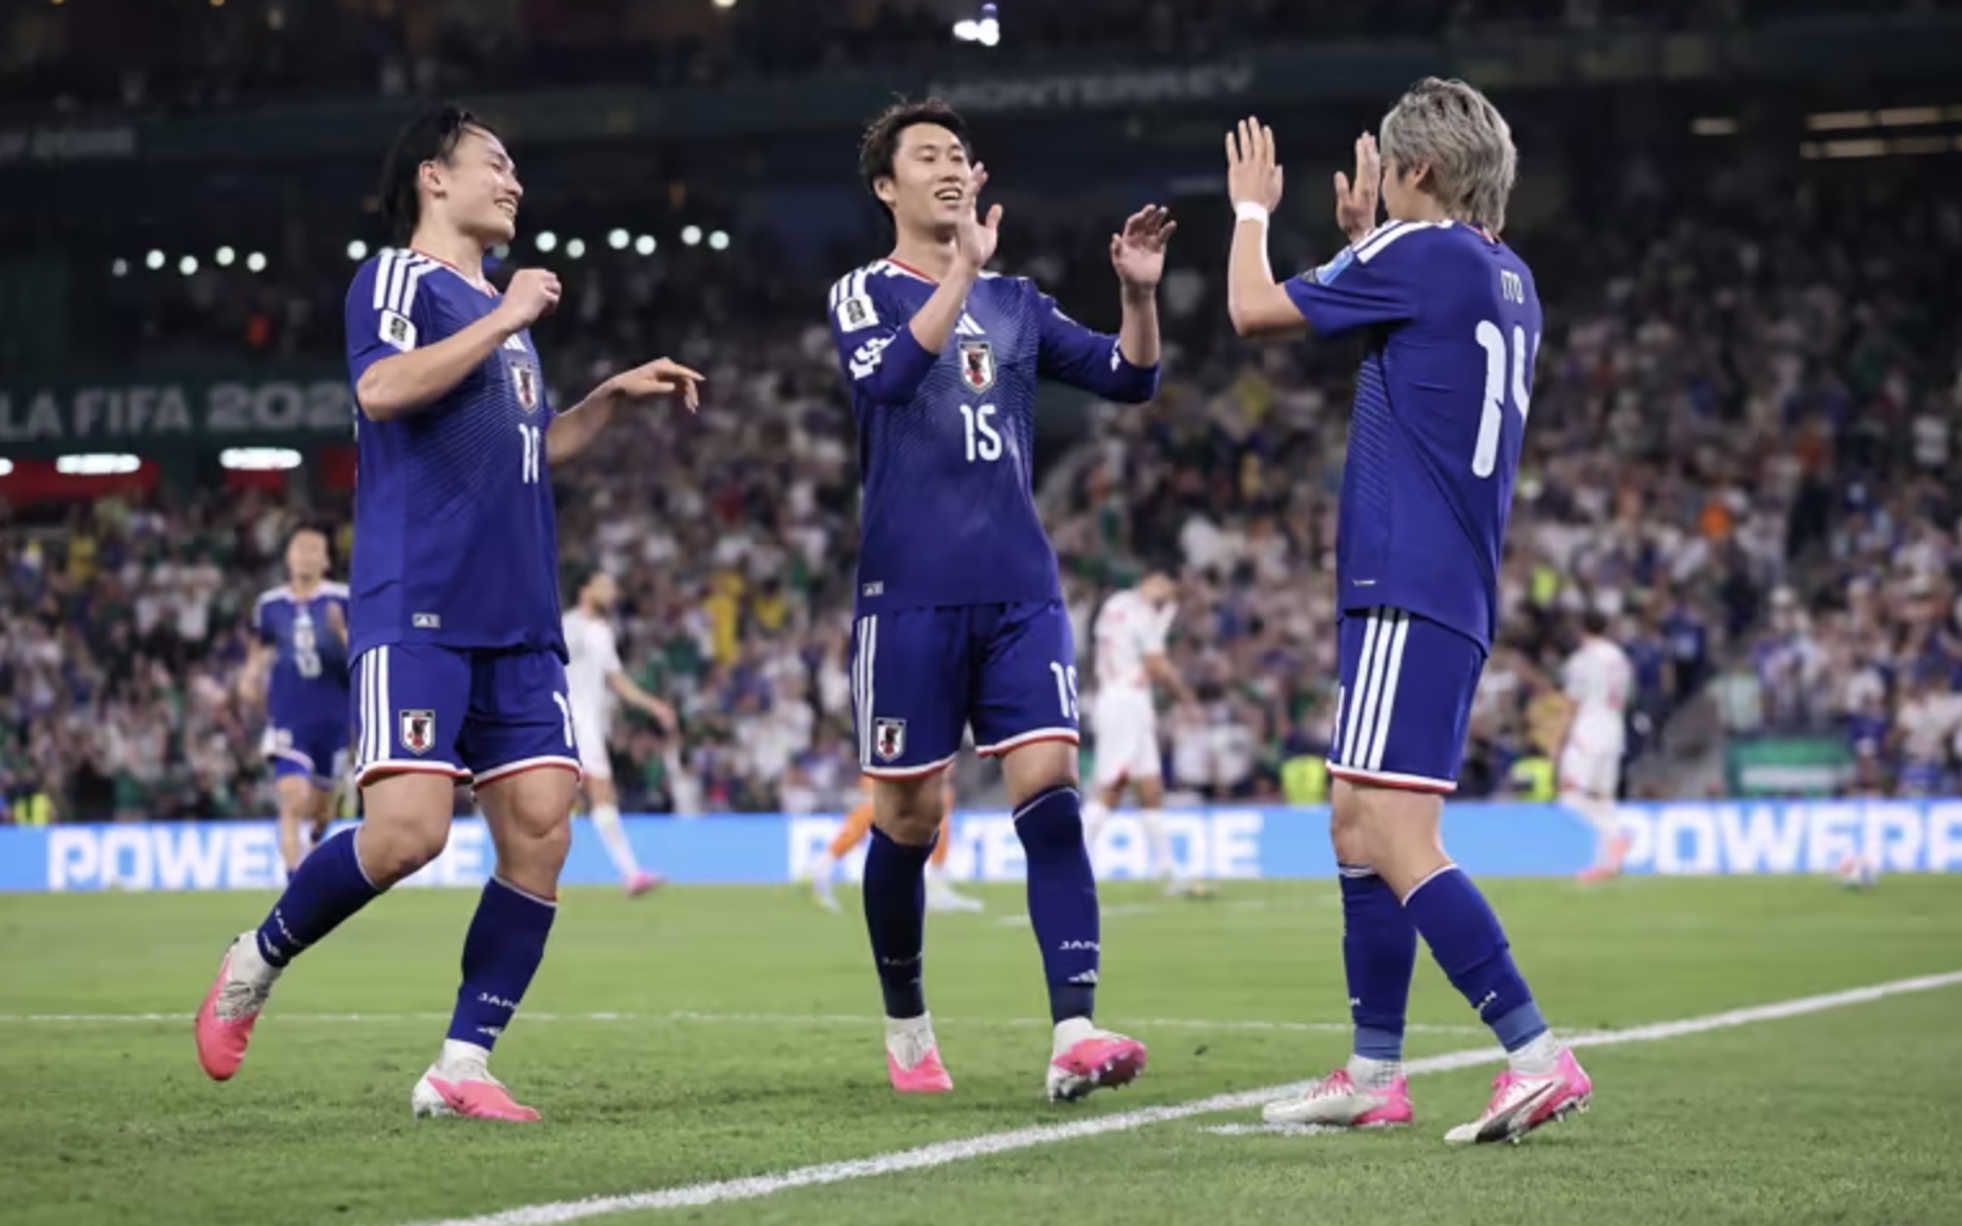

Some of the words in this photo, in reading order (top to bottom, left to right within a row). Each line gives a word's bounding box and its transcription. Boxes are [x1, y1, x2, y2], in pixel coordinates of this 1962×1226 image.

[1500, 268, 1525, 304] ITO
[73, 381, 192, 439] FIFA
[206, 376, 354, 432] 202
[960, 403, 1002, 462] 15
[552, 690, 573, 750] 1
[47, 824, 486, 889] POWEE
